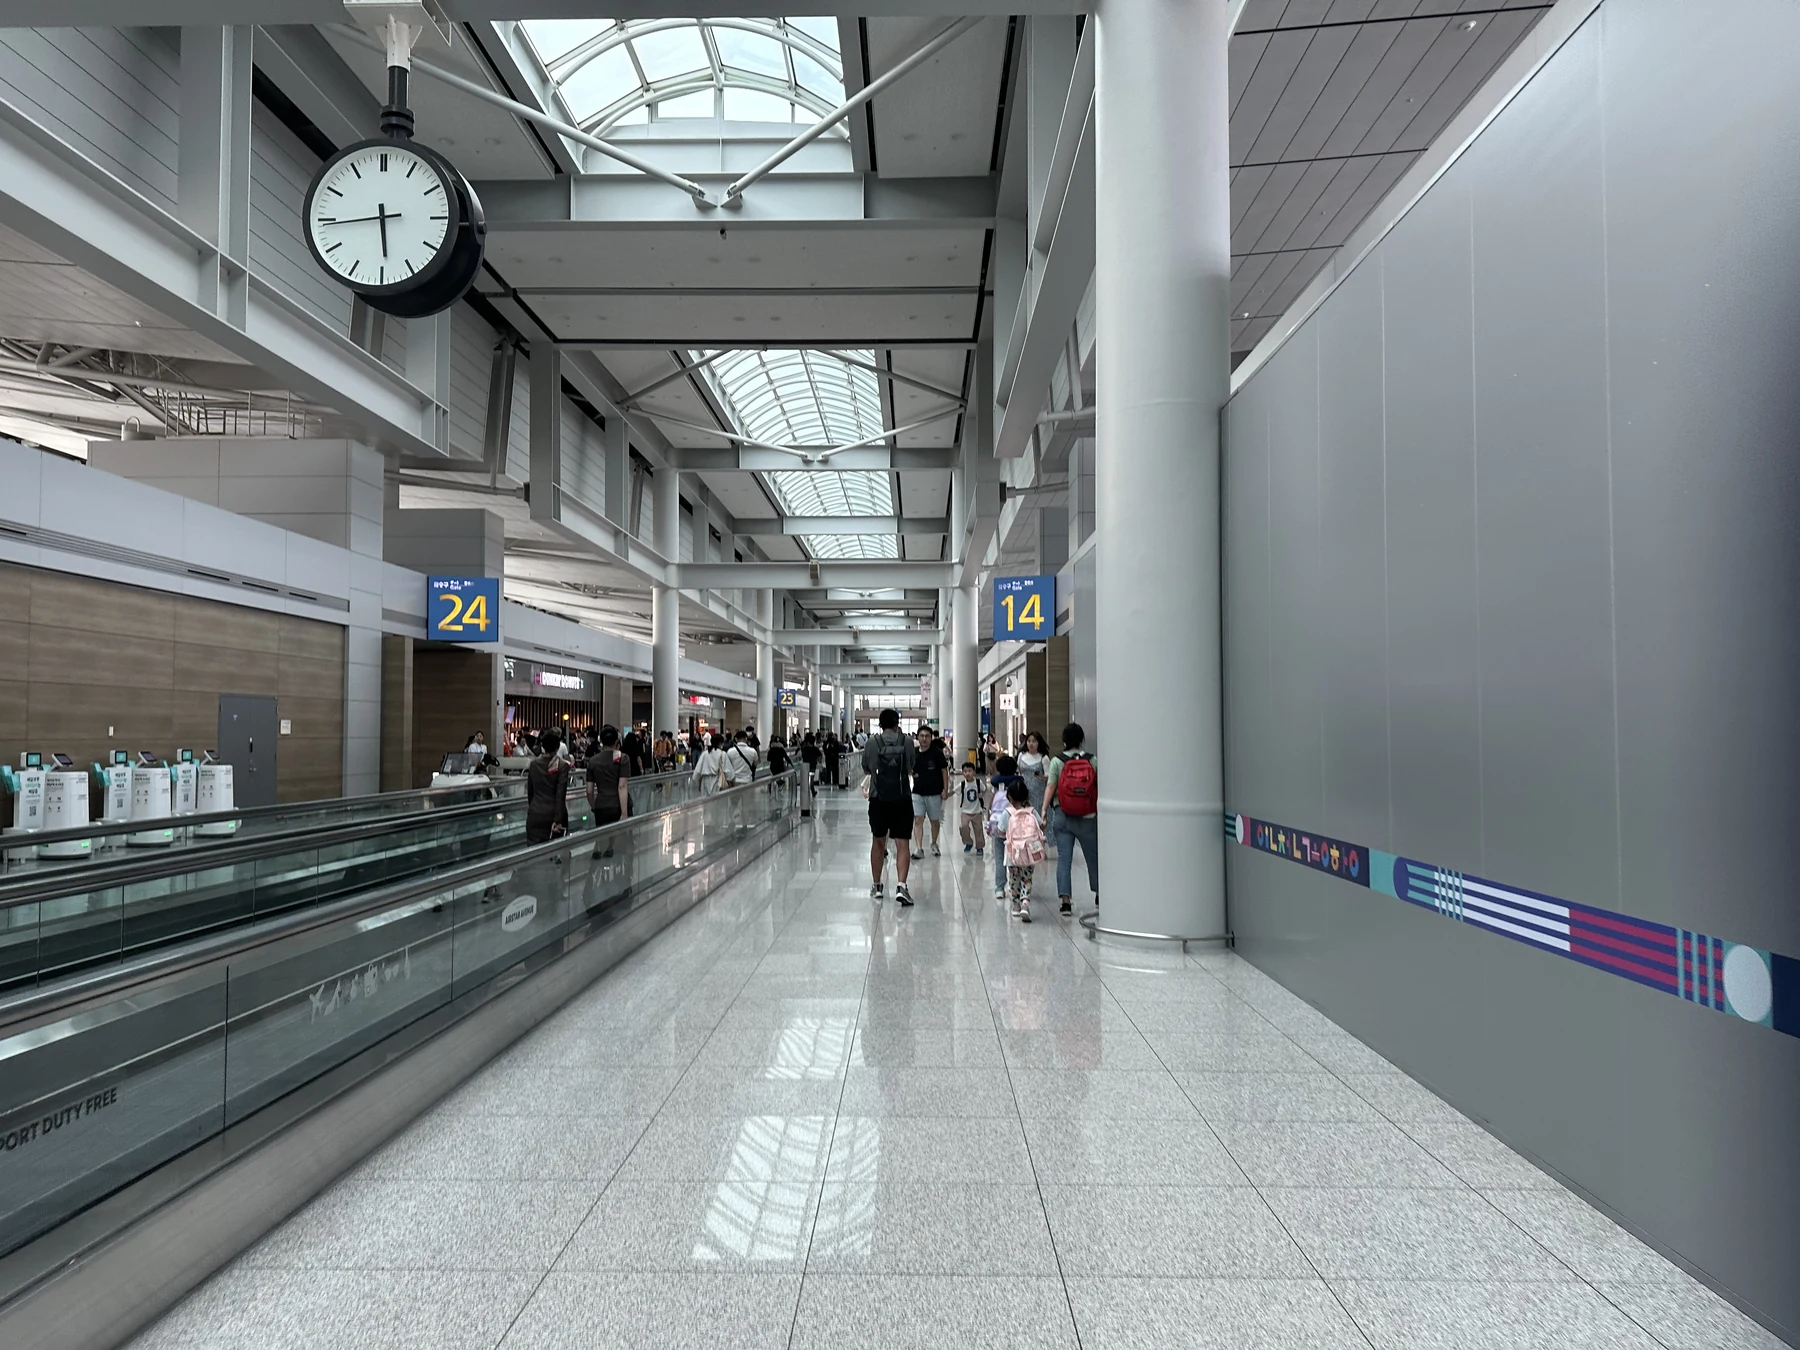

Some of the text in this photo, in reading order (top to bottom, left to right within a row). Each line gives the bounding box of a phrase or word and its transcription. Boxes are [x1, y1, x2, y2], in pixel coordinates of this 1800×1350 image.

[438, 593, 491, 632] 24
[1001, 594, 1045, 631] 14
[780, 692, 794, 704] 23
[42, 1102, 83, 1135] DUTY
[85, 1087, 117, 1116] FREE
